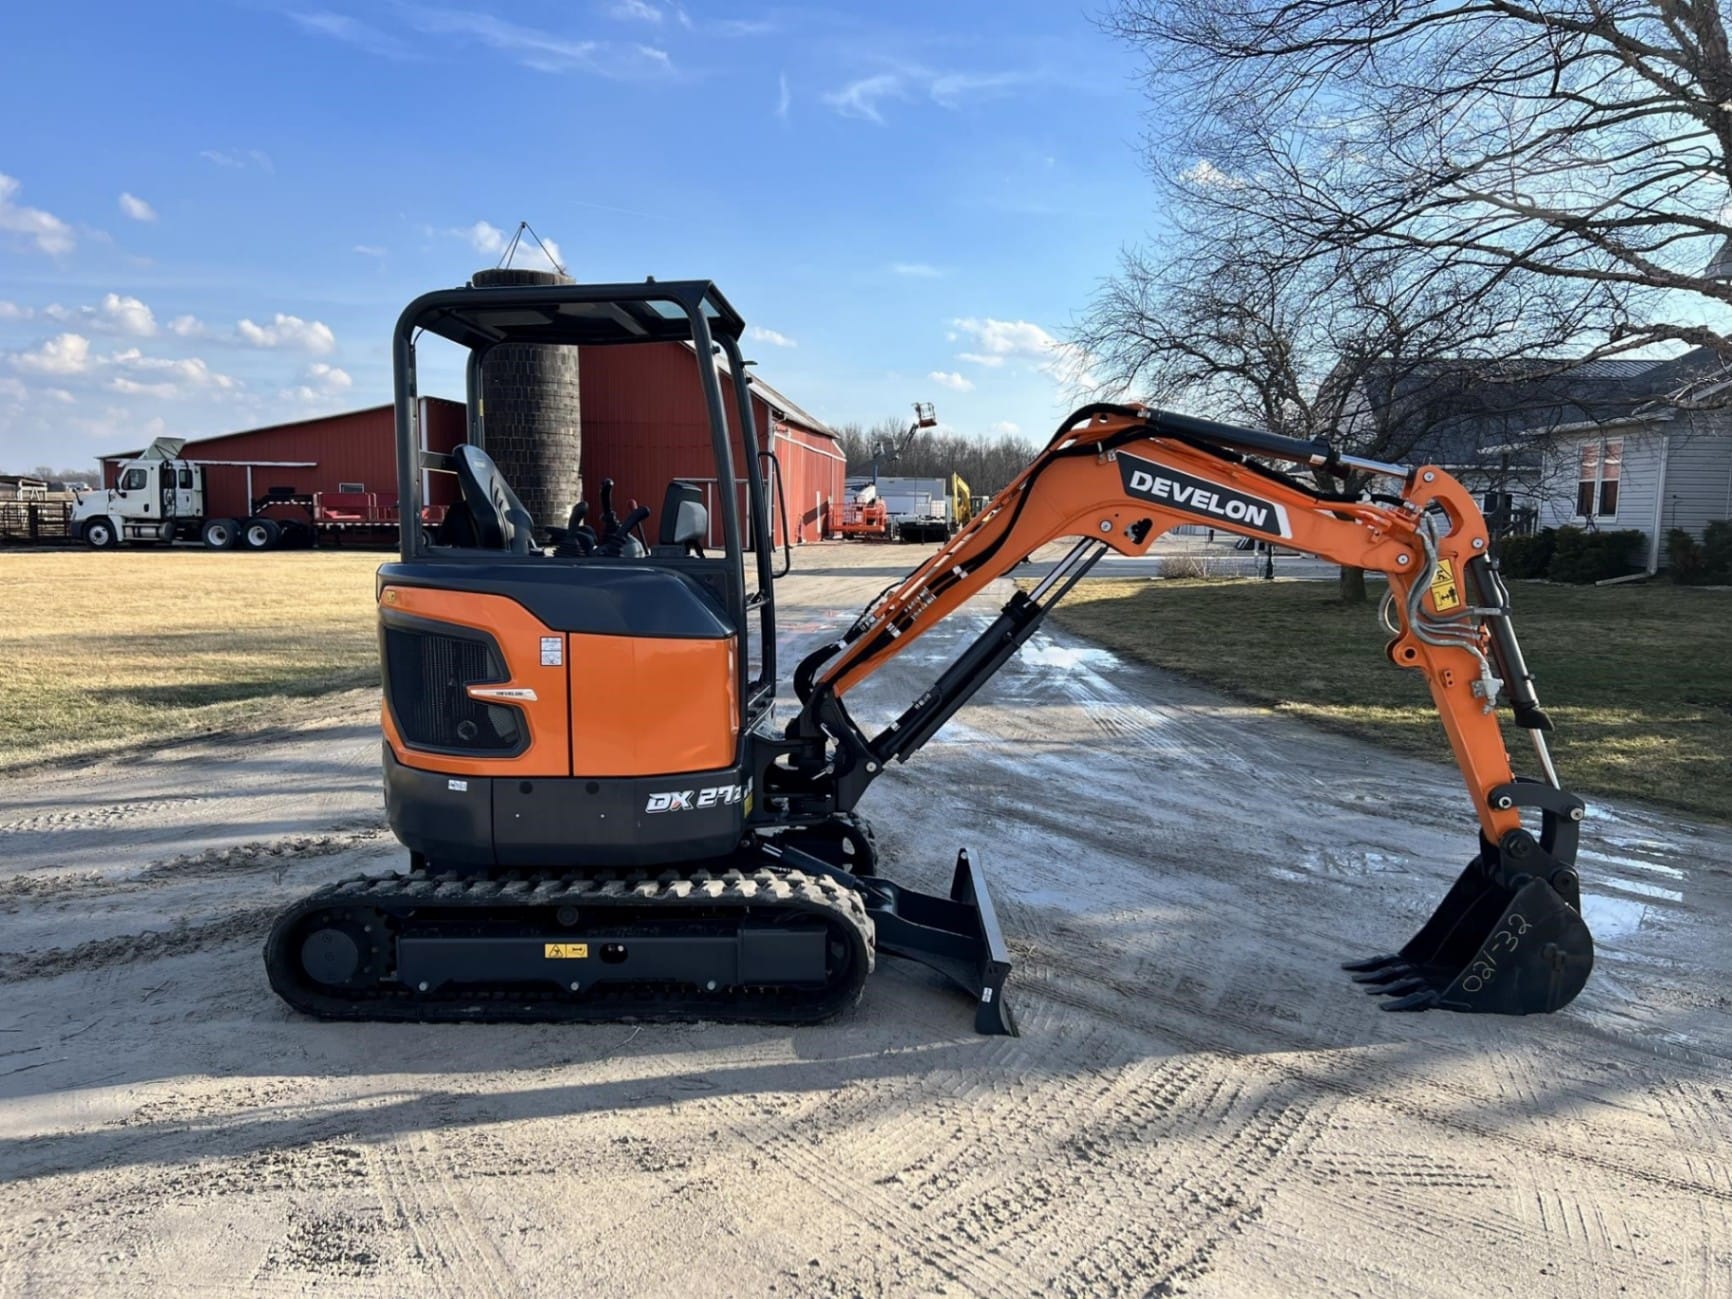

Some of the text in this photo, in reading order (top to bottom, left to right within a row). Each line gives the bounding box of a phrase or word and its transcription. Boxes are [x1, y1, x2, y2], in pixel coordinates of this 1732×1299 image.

[1129, 470, 1268, 527] DEVELON
[645, 790, 695, 813] DX
[1462, 913, 1533, 992] 021-32
